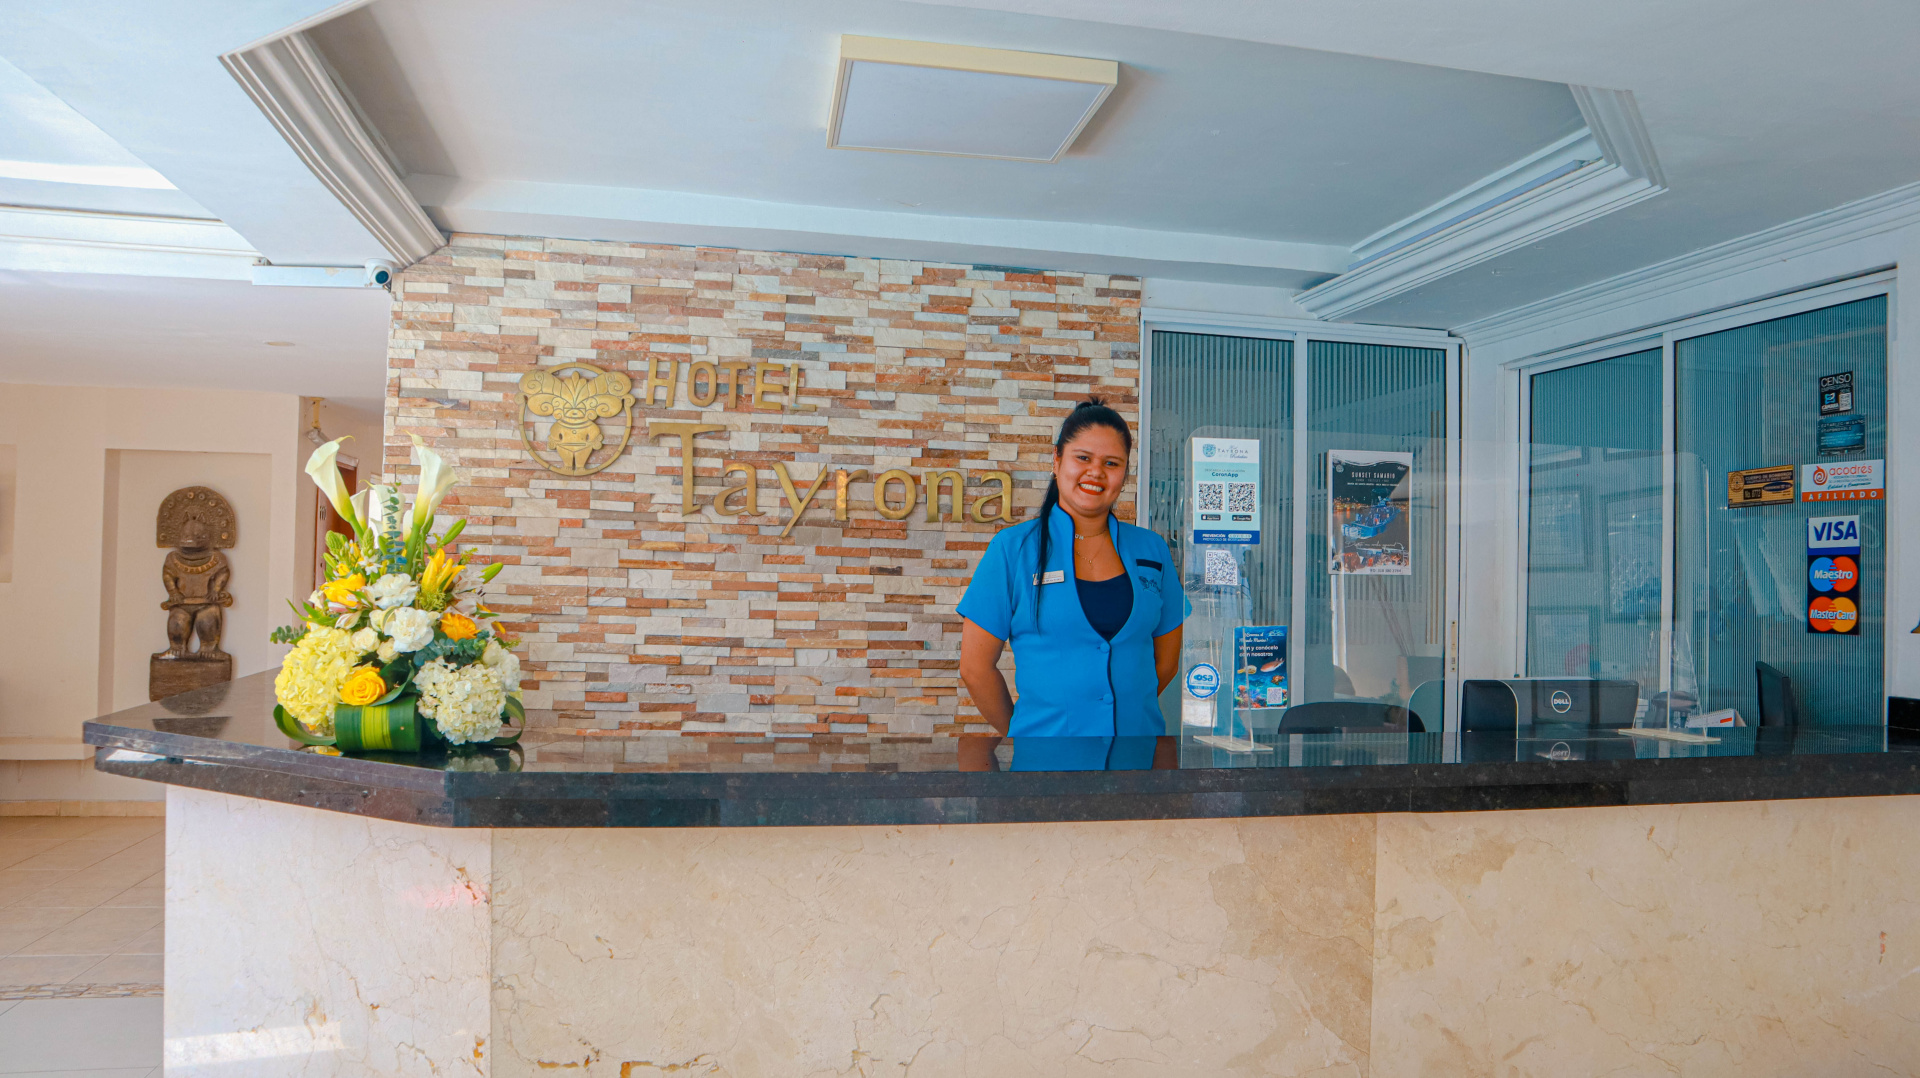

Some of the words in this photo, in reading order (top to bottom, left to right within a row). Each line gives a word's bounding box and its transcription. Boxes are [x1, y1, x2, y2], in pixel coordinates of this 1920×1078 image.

[646, 357, 817, 411] HOTEL
[1820, 373, 1852, 387] CENSO
[1829, 463, 1873, 476] acodrés
[648, 421, 1020, 538] Tayrona
[1808, 490, 1878, 501] AFILIADO
[1813, 521, 1858, 541] VISA
[1814, 569, 1853, 580] Maestro
[1810, 609, 1856, 620] MasterCard
